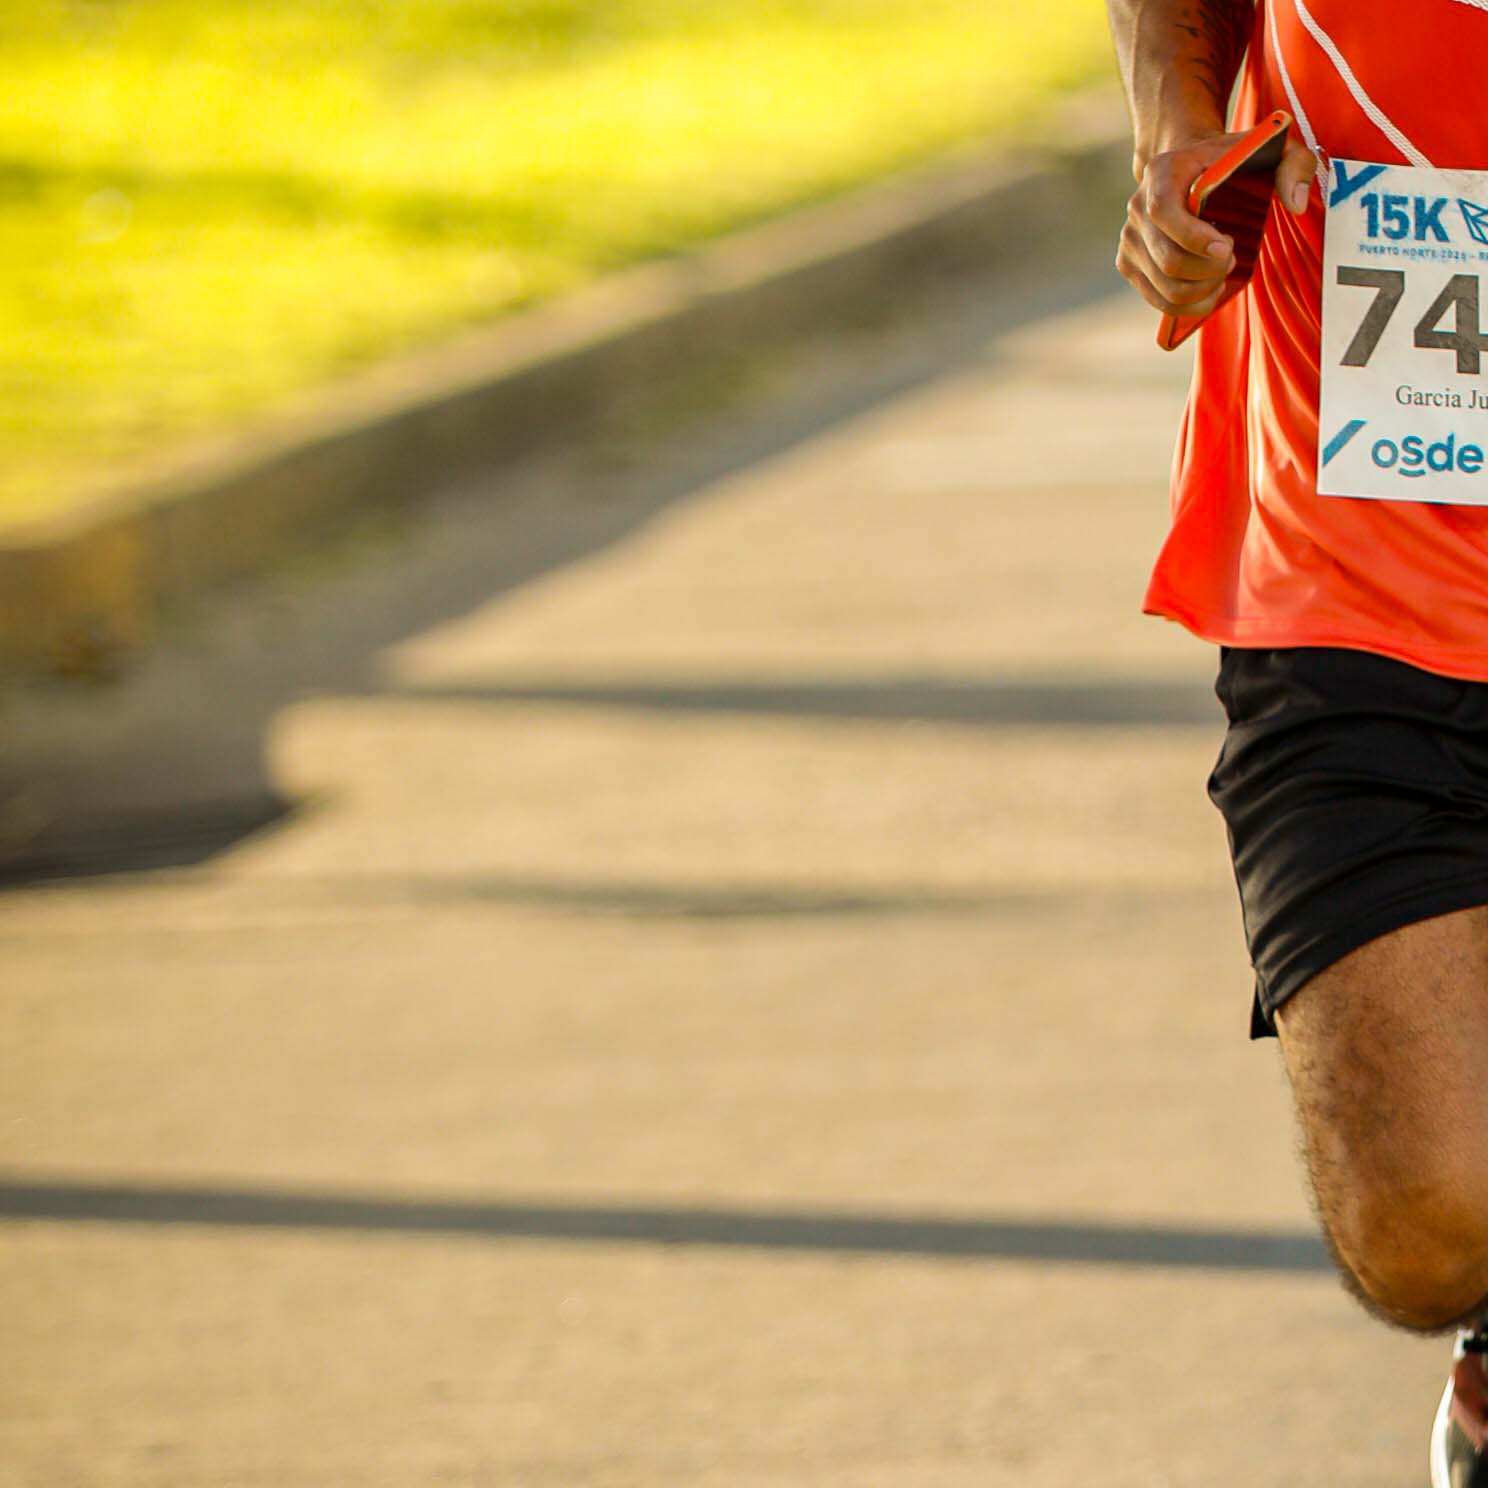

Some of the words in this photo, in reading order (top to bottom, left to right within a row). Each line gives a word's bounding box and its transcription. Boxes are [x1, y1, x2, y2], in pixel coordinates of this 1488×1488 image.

[1360, 192, 1449, 242] 15K
[1359, 244, 1399, 256] PUERTO
[1395, 385, 1462, 409] Garcia
[1371, 432, 1484, 474] osde
